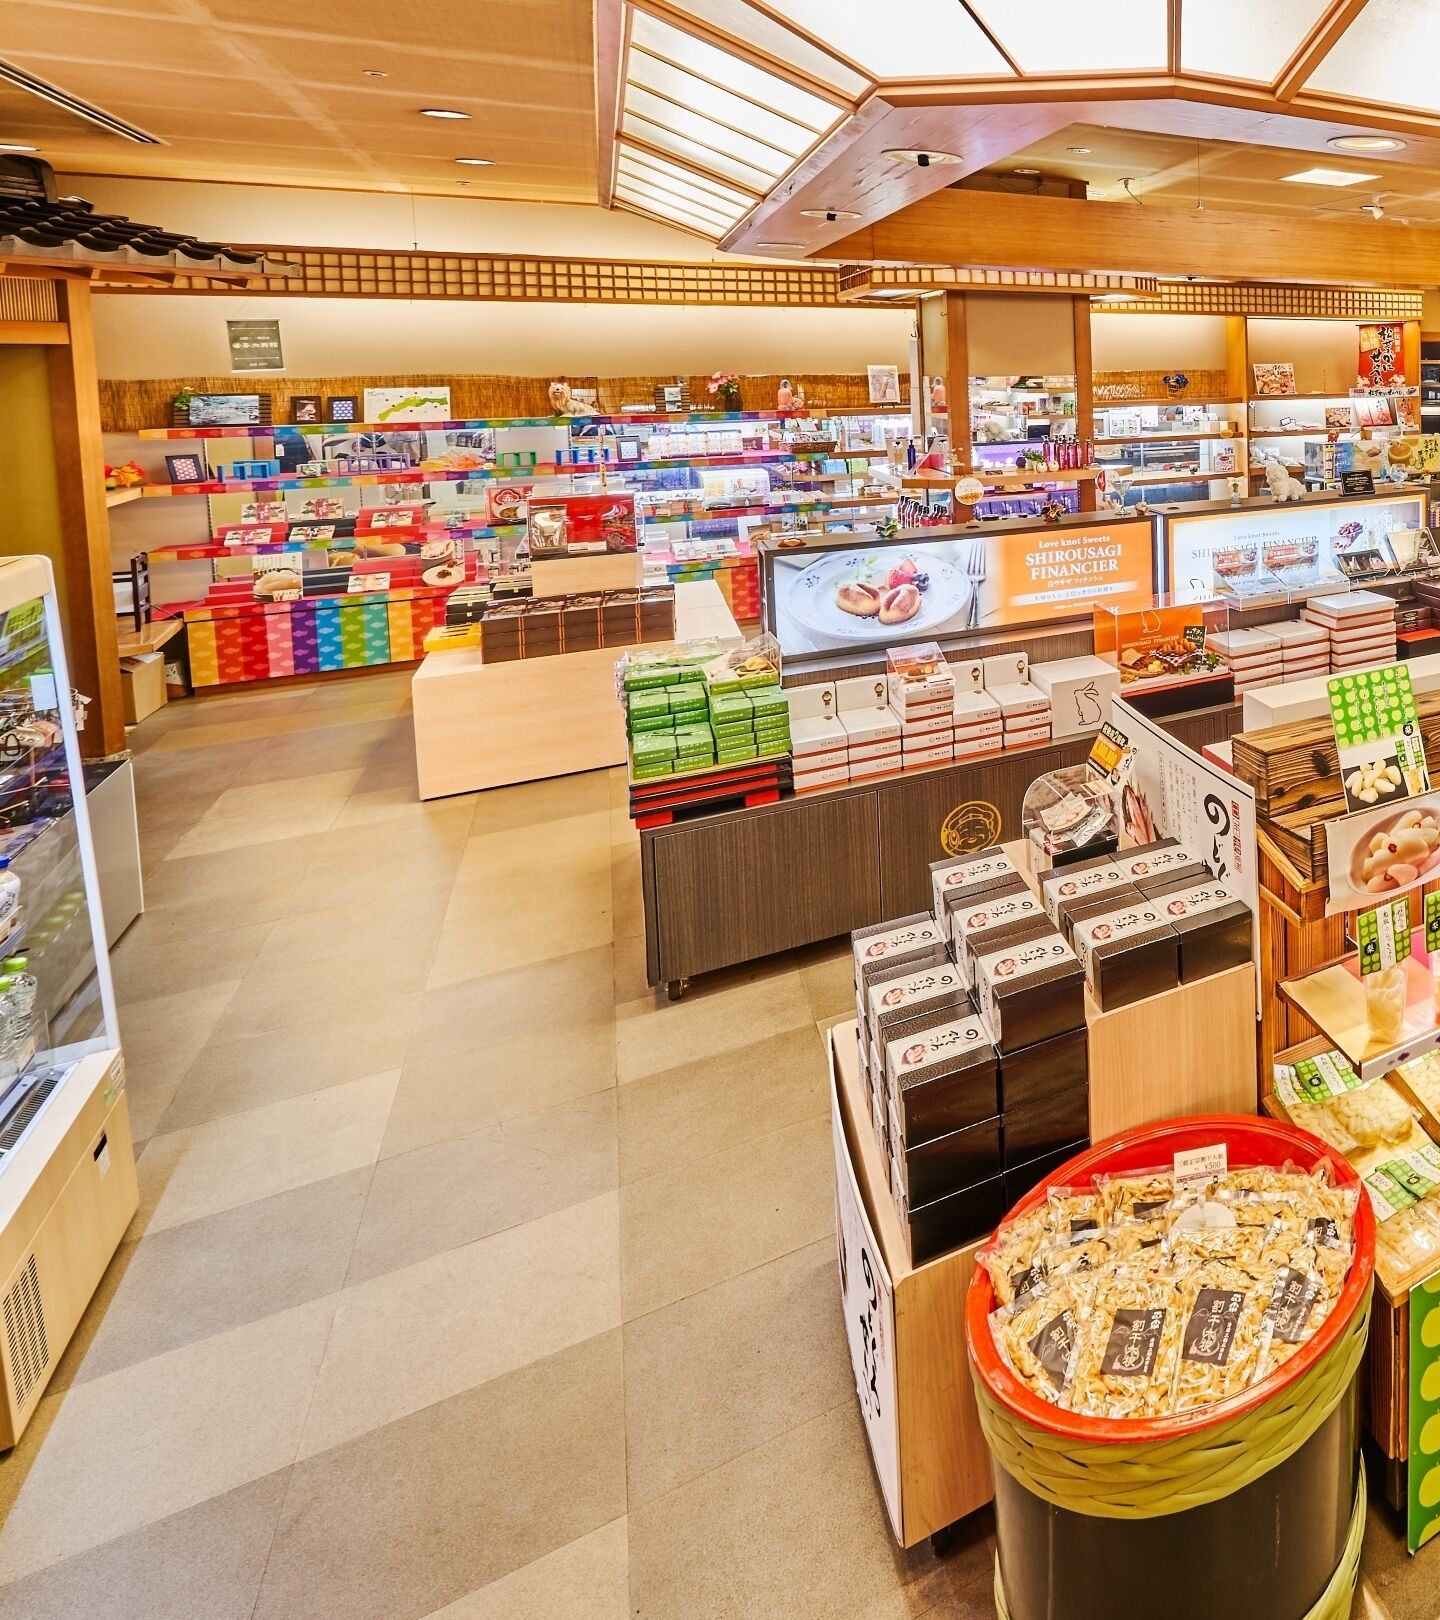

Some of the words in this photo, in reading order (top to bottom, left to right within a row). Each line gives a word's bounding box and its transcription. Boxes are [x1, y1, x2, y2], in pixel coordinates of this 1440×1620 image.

[1039, 539, 1060, 549] Love
[1061, 537, 1080, 547] knot
[1082, 535, 1111, 544] Sweets
[1025, 543, 1123, 567] SHIROUSAGI
[1030, 558, 1119, 581] FINANCIER
[1204, 1160, 1221, 1170] ¥500
[1198, 1299, 1226, 1353] 割干大根
[1121, 1319, 1146, 1368] 割干大根
